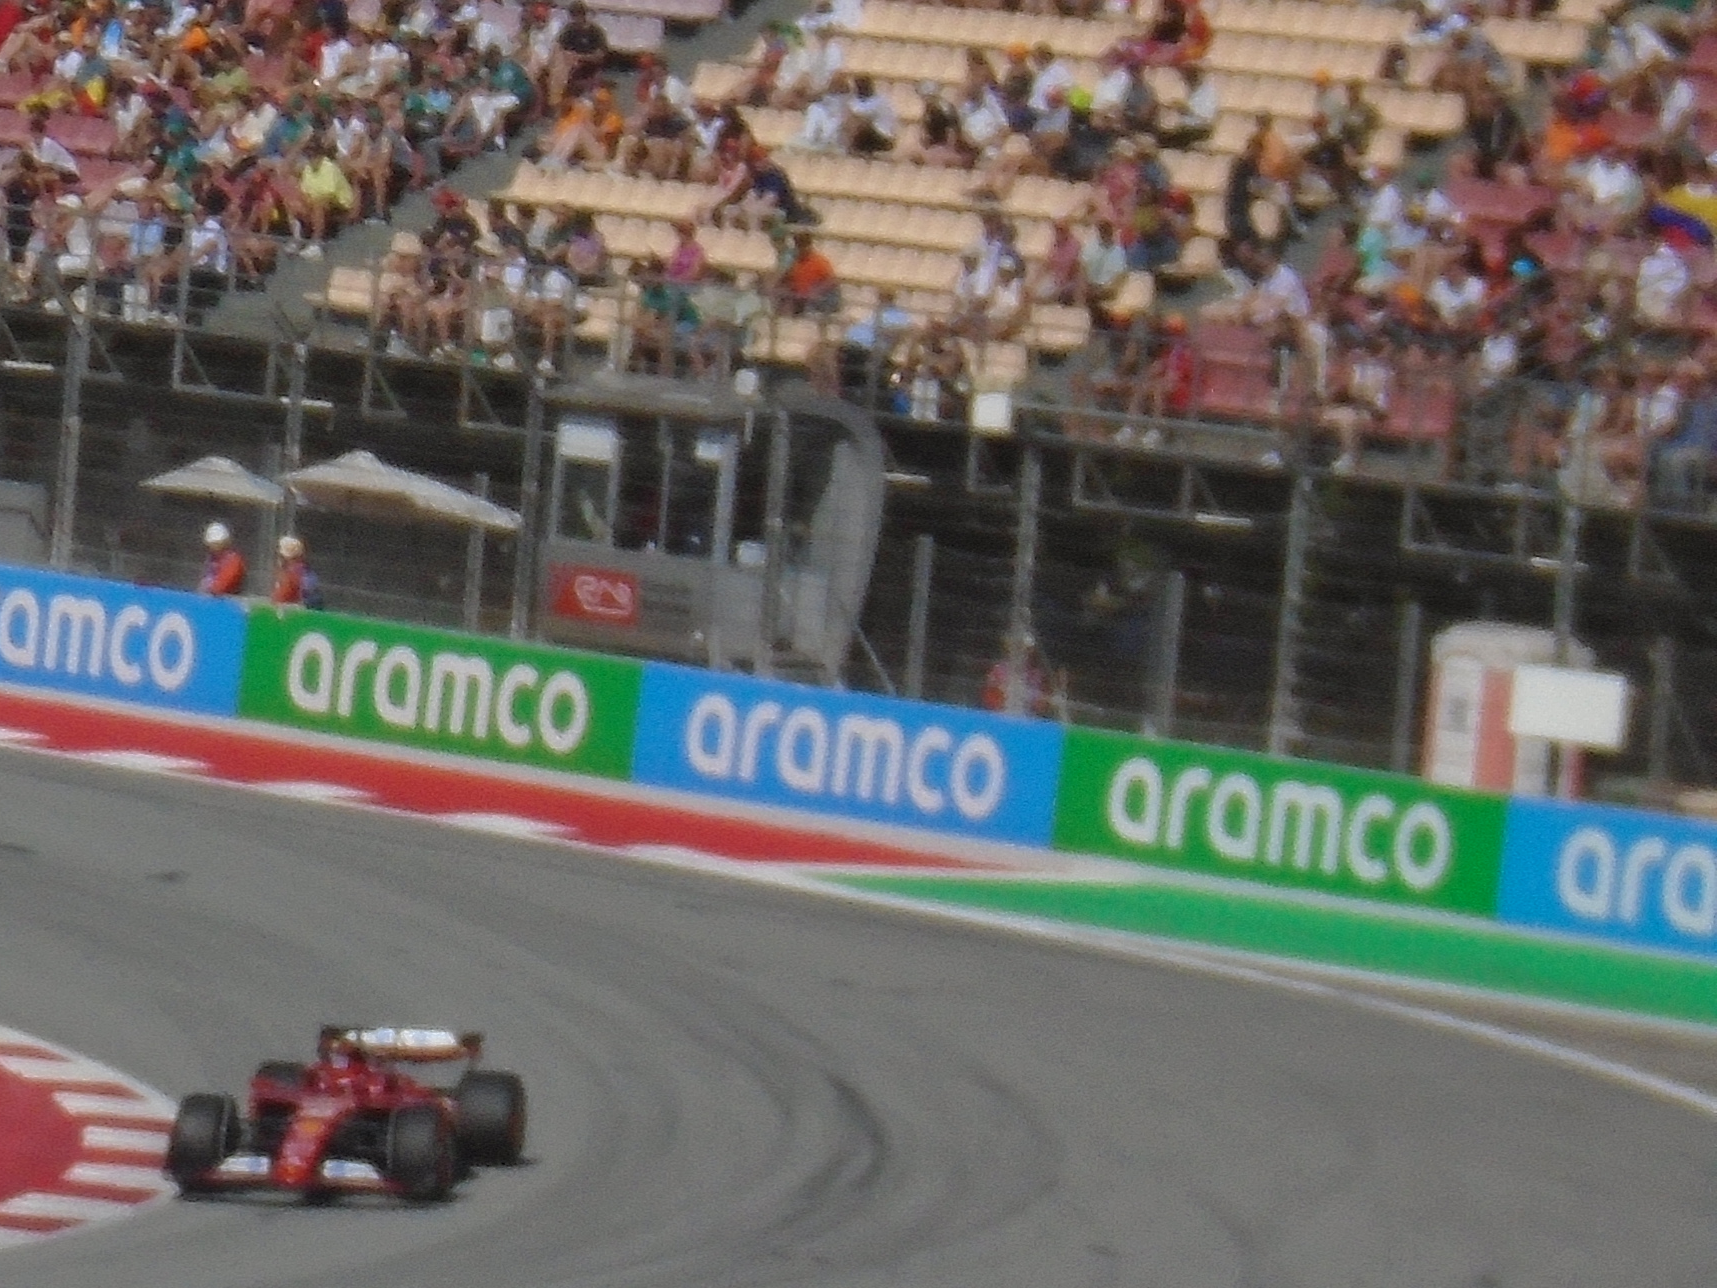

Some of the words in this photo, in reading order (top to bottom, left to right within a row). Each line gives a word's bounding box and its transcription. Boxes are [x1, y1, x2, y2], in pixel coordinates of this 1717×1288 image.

[287, 632, 589, 755] aramco
[685, 692, 1006, 820] aramco
[1106, 755, 1453, 892] aramco
